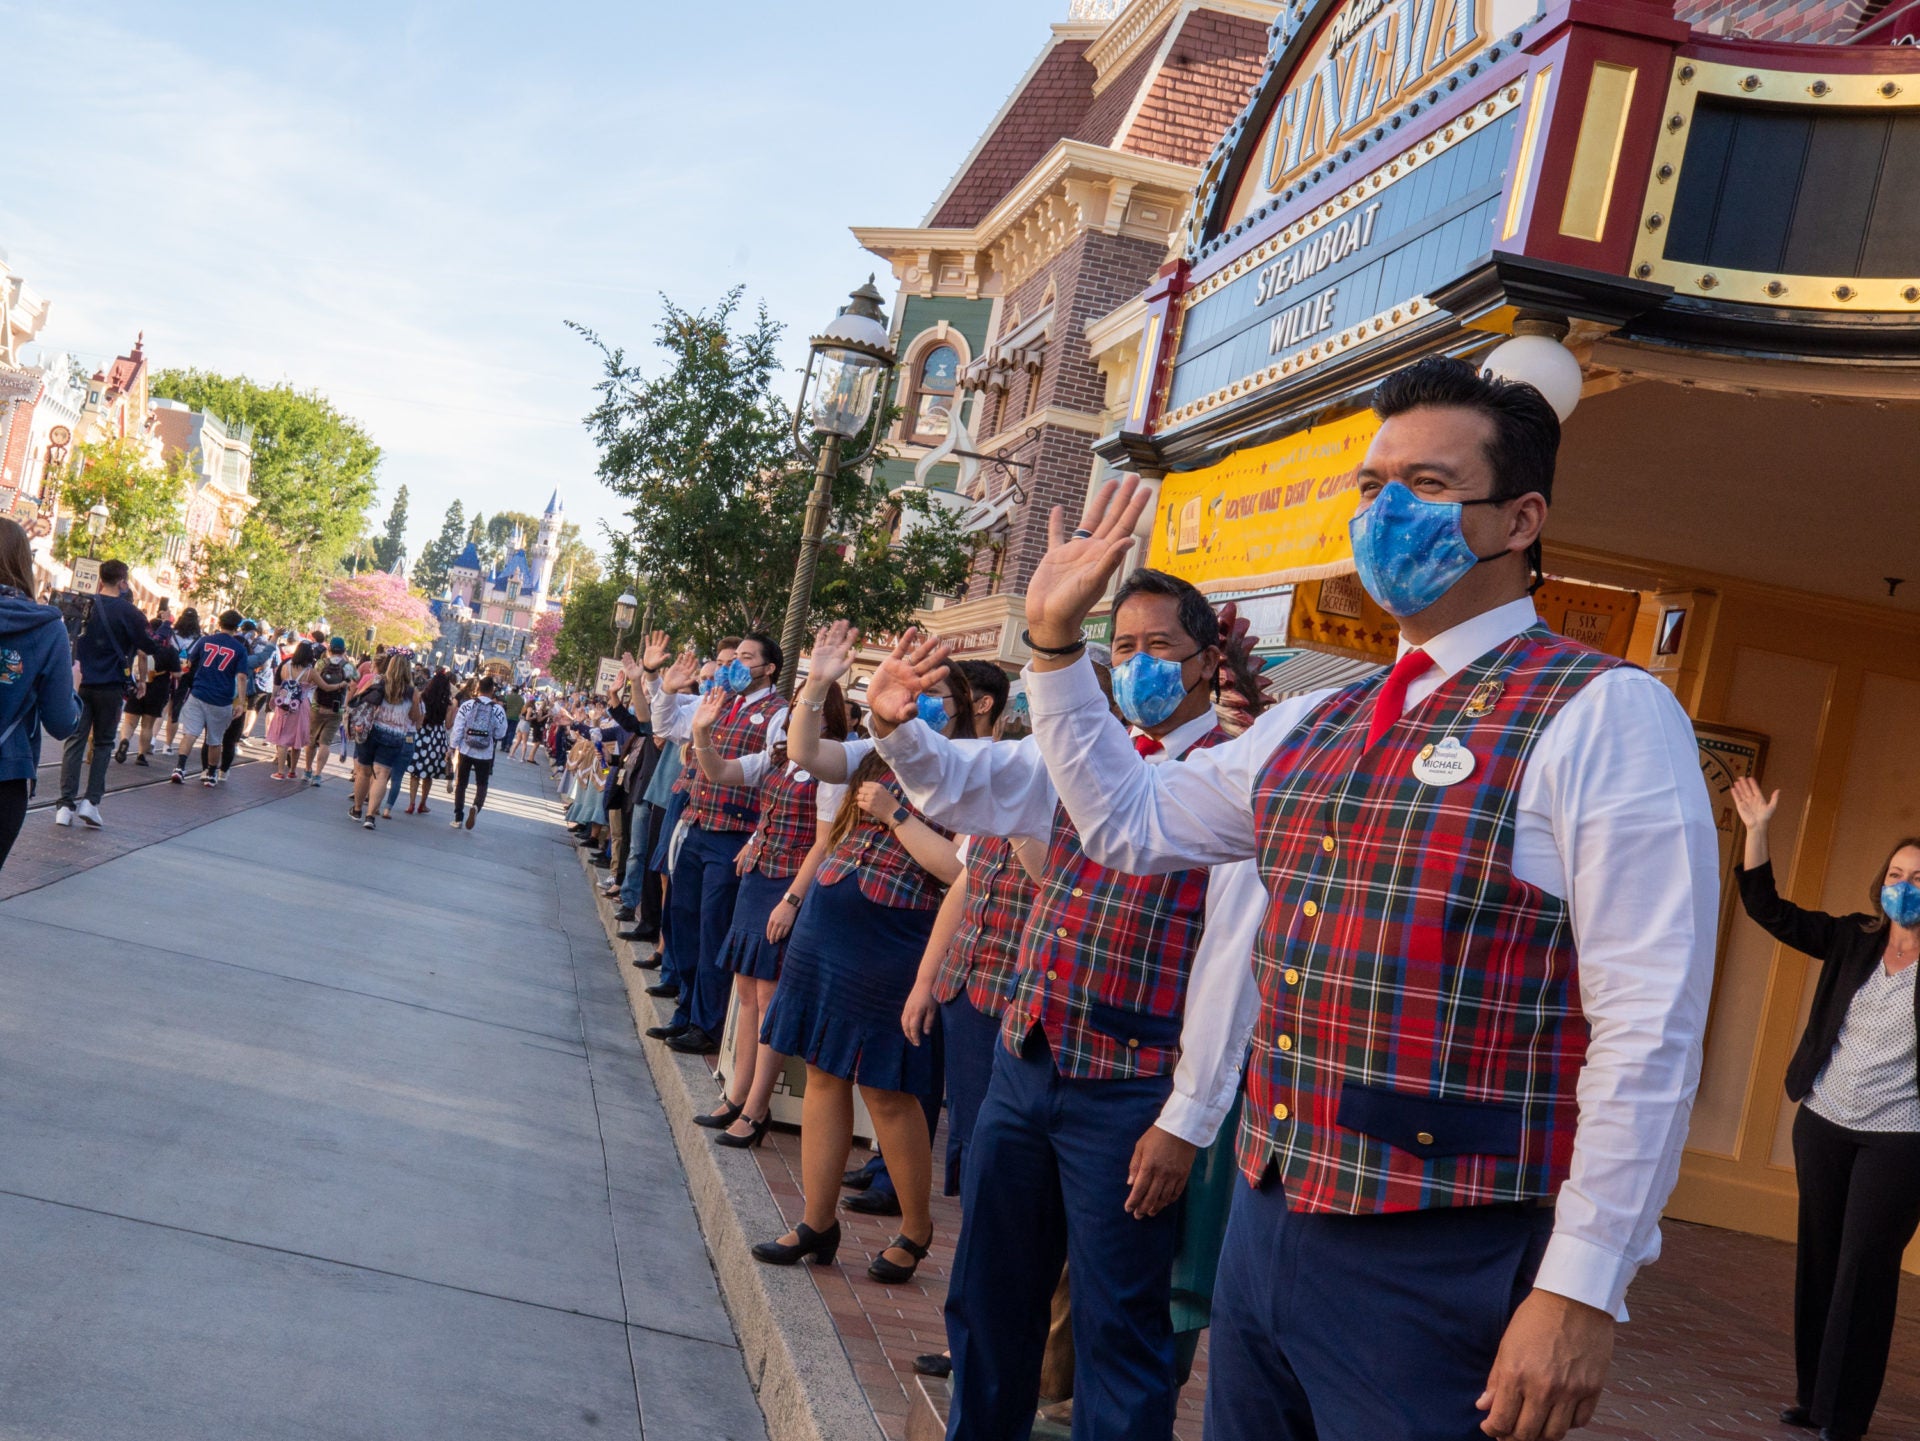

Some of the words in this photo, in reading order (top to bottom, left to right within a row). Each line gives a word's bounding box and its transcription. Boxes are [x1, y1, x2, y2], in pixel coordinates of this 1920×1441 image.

[1254, 201, 1382, 307] STEAMBOAT
[1268, 287, 1338, 356] WILLIE
[1323, 594, 1358, 614] SCREENS
[1579, 615, 1597, 630] SIX
[203, 642, 236, 672] 77
[1422, 759, 1463, 770] MICHAEL
